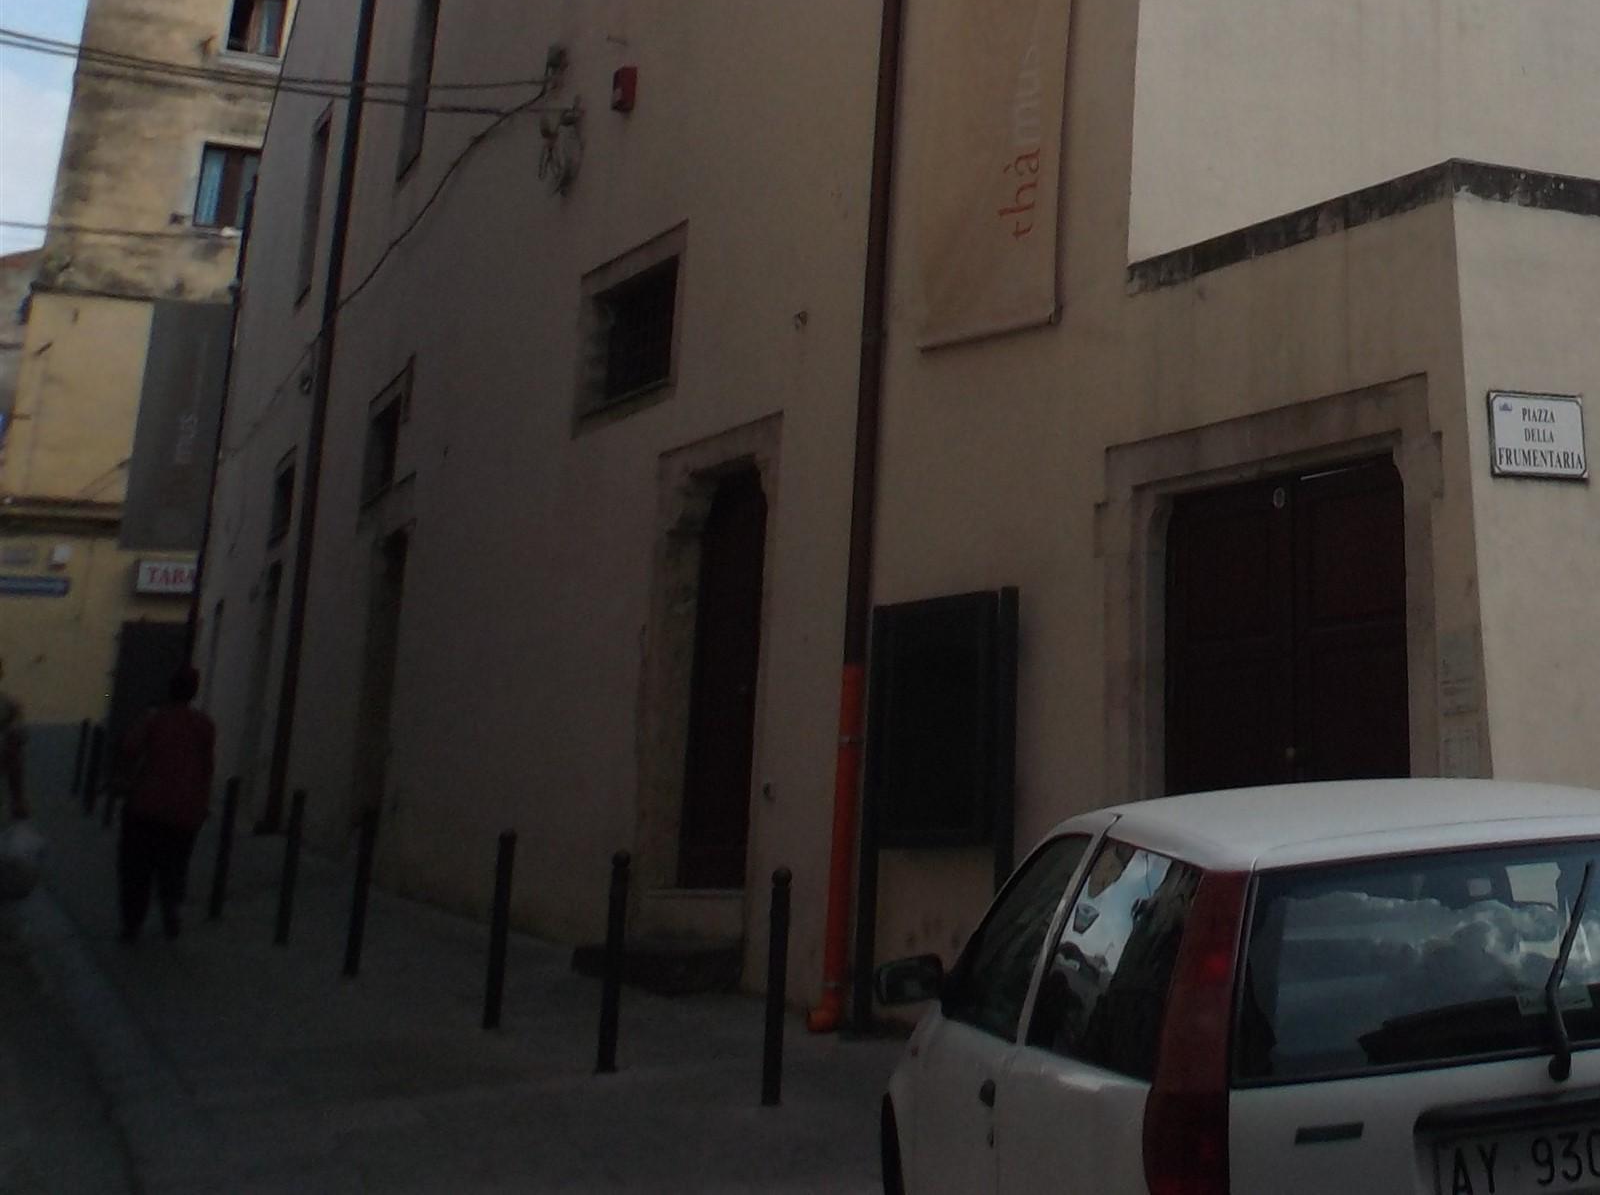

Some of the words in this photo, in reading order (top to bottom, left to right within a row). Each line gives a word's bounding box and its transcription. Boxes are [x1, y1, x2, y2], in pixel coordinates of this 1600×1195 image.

[1522, 407, 1555, 423] PIAZZA
[1524, 428, 1554, 443] DELLA
[1498, 447, 1584, 470] FRUMENTARIA
[1452, 1143, 1499, 1195] AY
